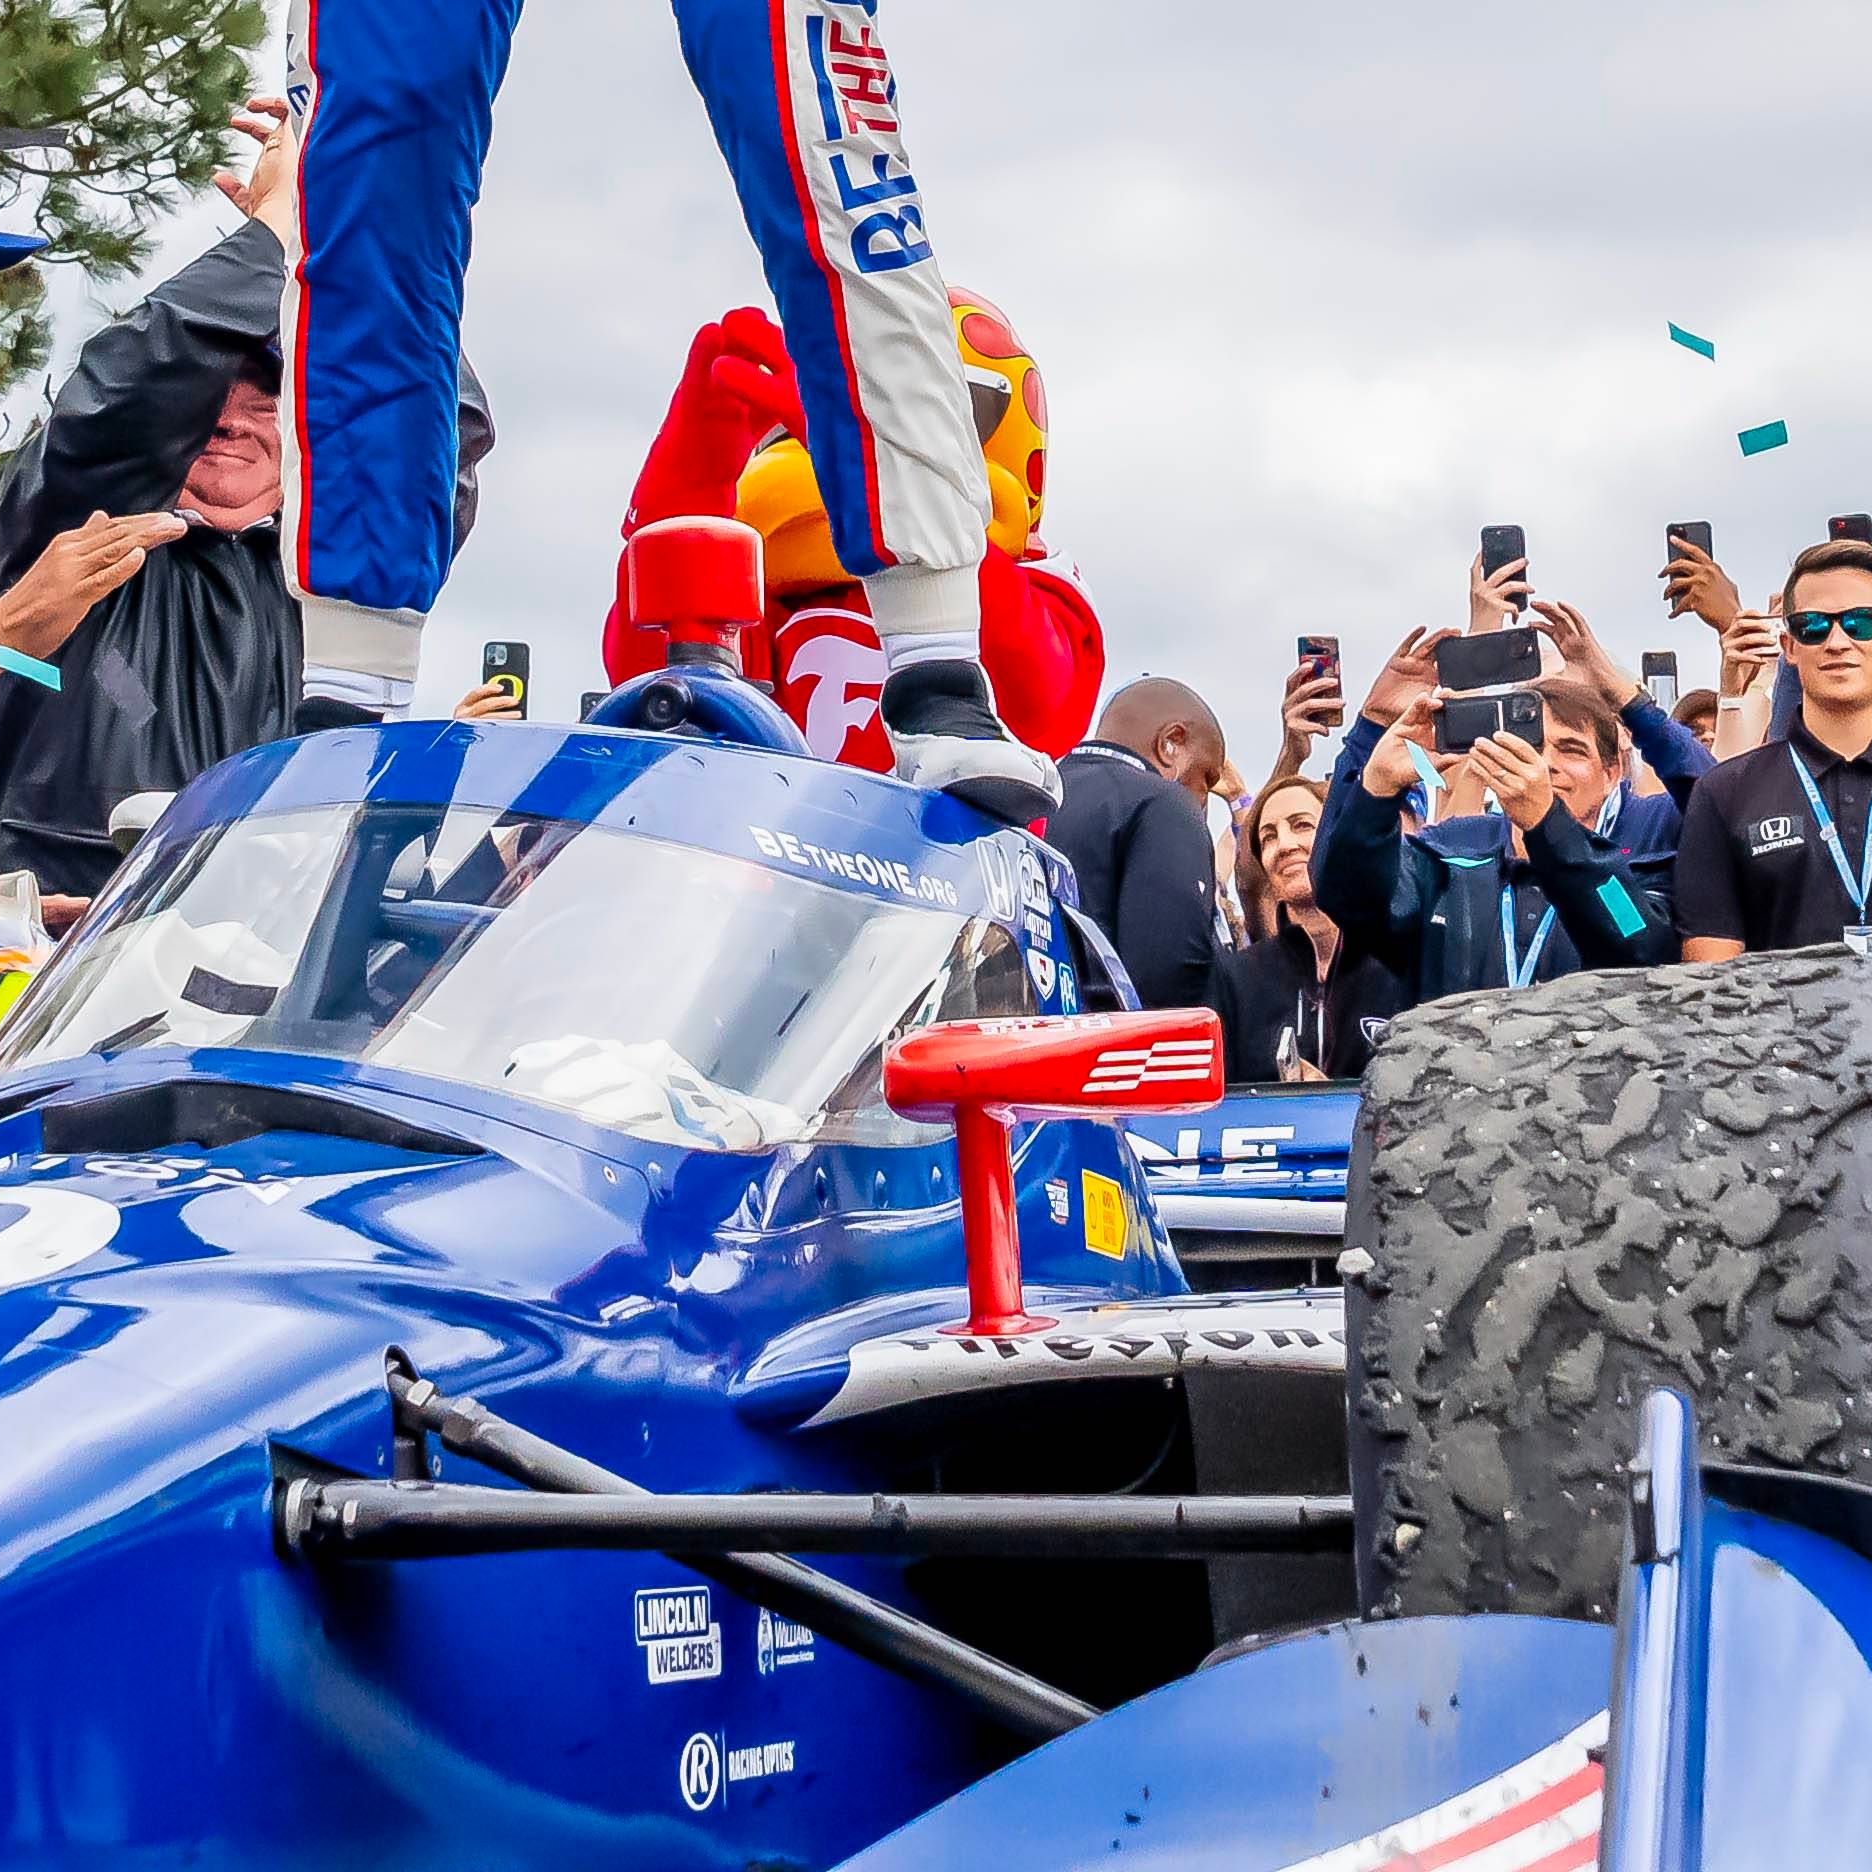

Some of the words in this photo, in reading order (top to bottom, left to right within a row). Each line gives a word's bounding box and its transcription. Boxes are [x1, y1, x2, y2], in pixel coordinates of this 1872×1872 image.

[828, 20, 898, 134] THE
[827, 150, 933, 275] BE
[748, 824, 960, 907] BETHEONE.ORG
[1751, 836, 1805, 857] HONDA
[638, 1595, 707, 1636] LINCOLN
[655, 1642, 715, 1675] WELDERS
[728, 1745, 763, 1782] RACING
[763, 1740, 796, 1775] OPTICS
